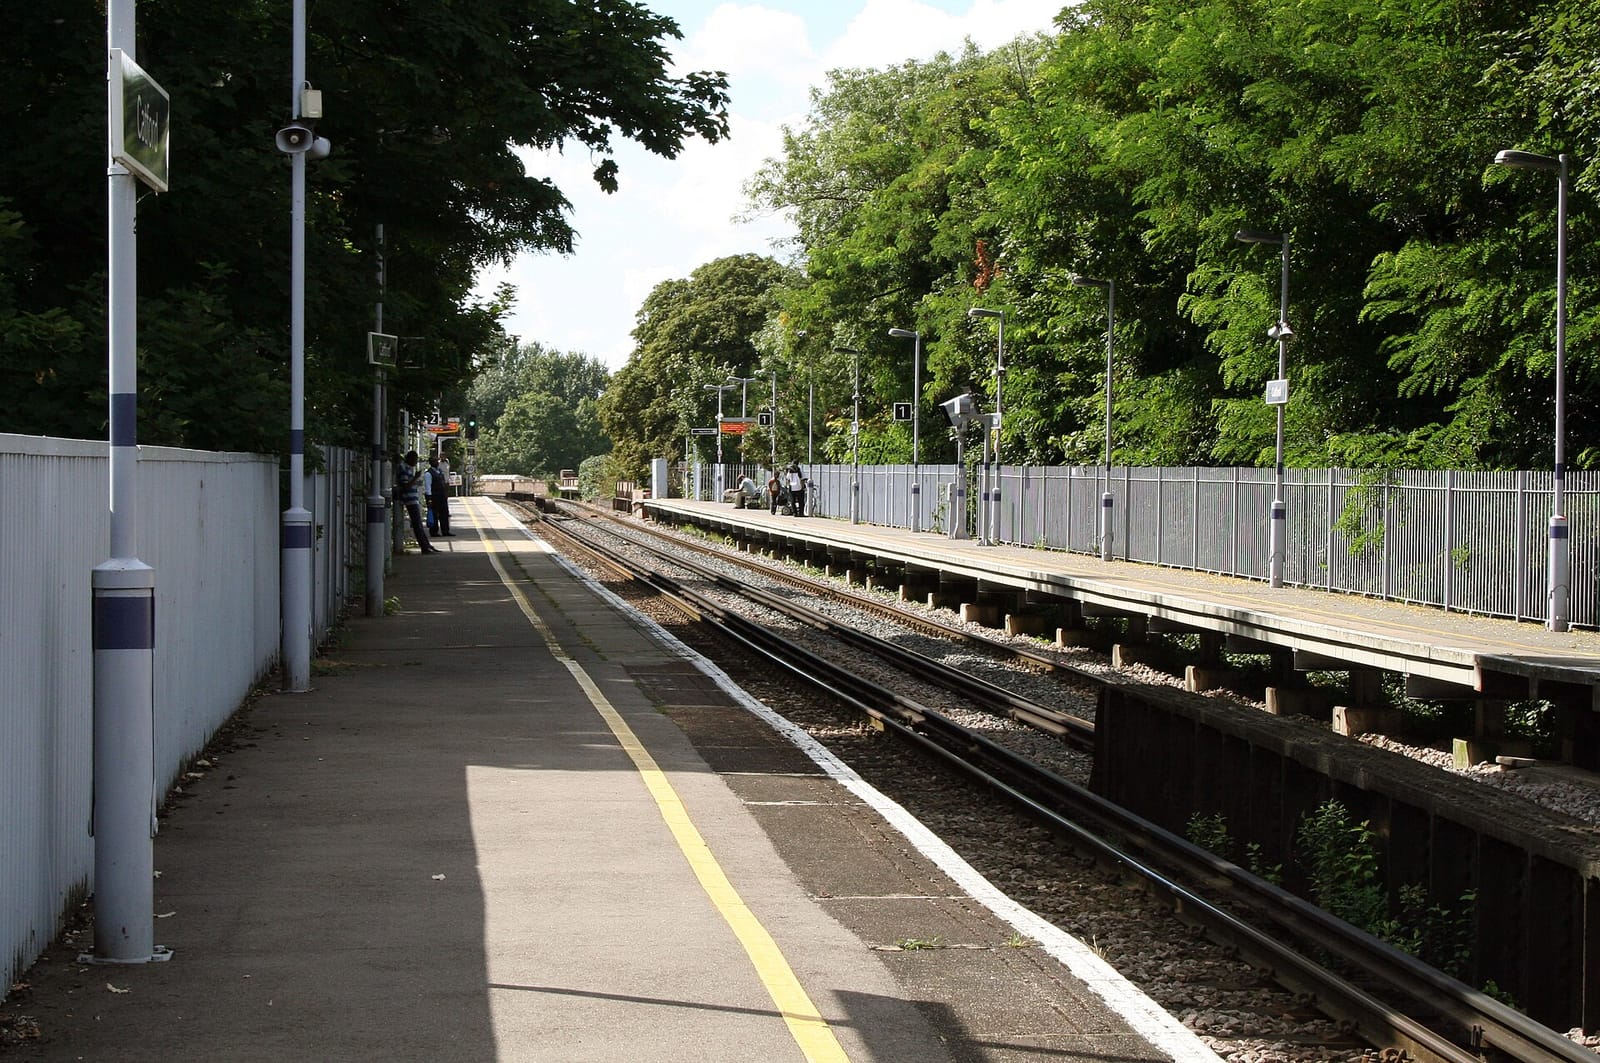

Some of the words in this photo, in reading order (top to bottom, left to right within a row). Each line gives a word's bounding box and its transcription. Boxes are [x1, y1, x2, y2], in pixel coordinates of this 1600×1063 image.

[899, 406, 905, 418] 1
[430, 416, 436, 424] 2
[762, 416, 766, 424] 1
